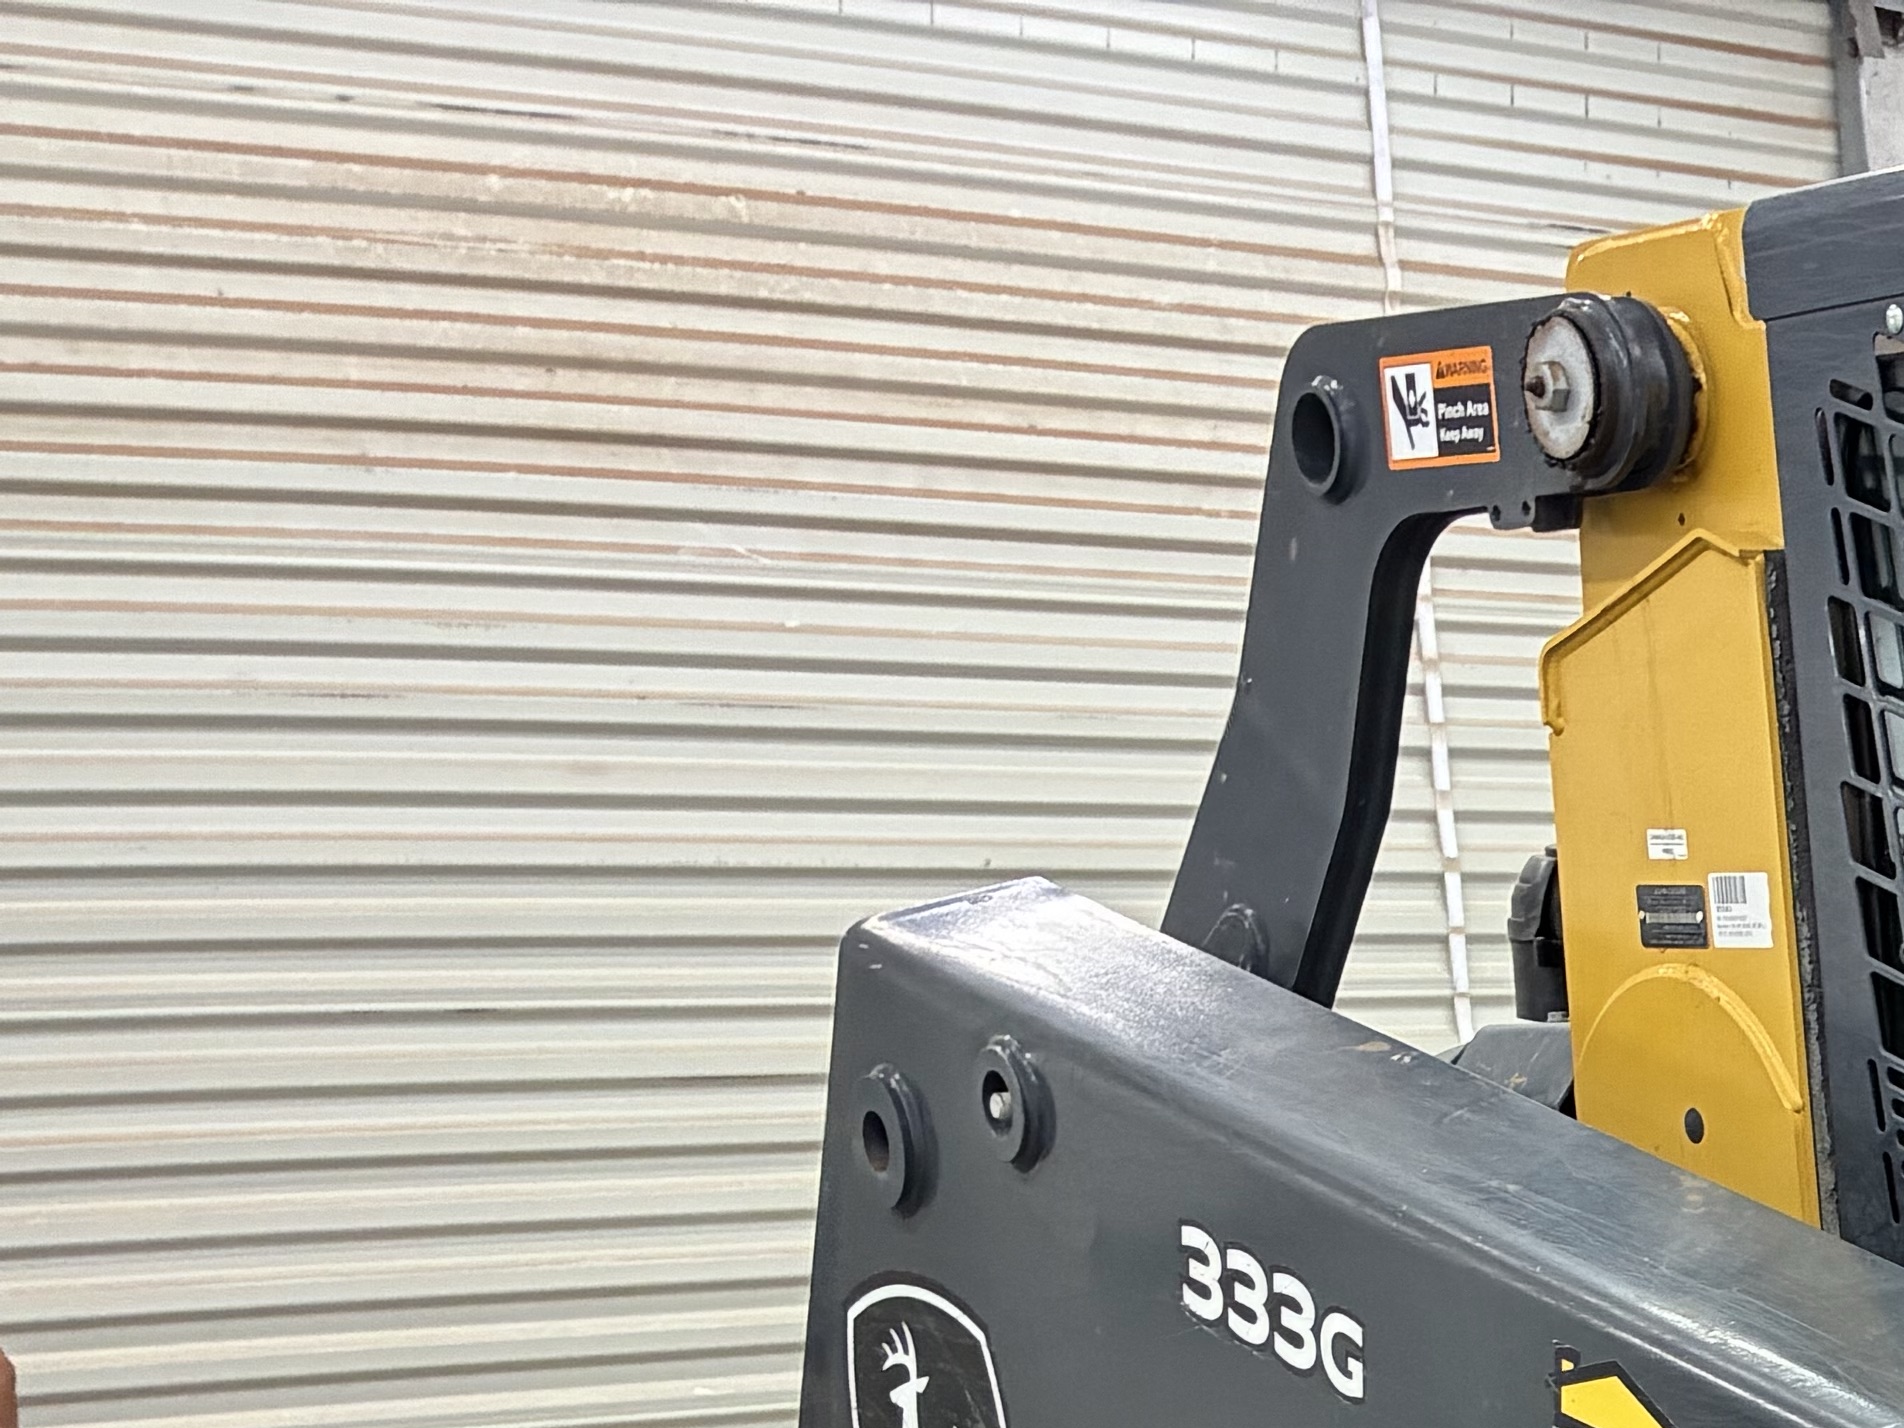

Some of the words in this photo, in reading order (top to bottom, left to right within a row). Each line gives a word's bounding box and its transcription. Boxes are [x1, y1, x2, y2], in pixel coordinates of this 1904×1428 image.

[1437, 402, 1465, 419] Pinch
[1466, 400, 1489, 417] Area
[1440, 427, 1460, 444] Keep
[1461, 425, 1484, 442] Away
[1181, 1224, 1364, 1399] 333G
